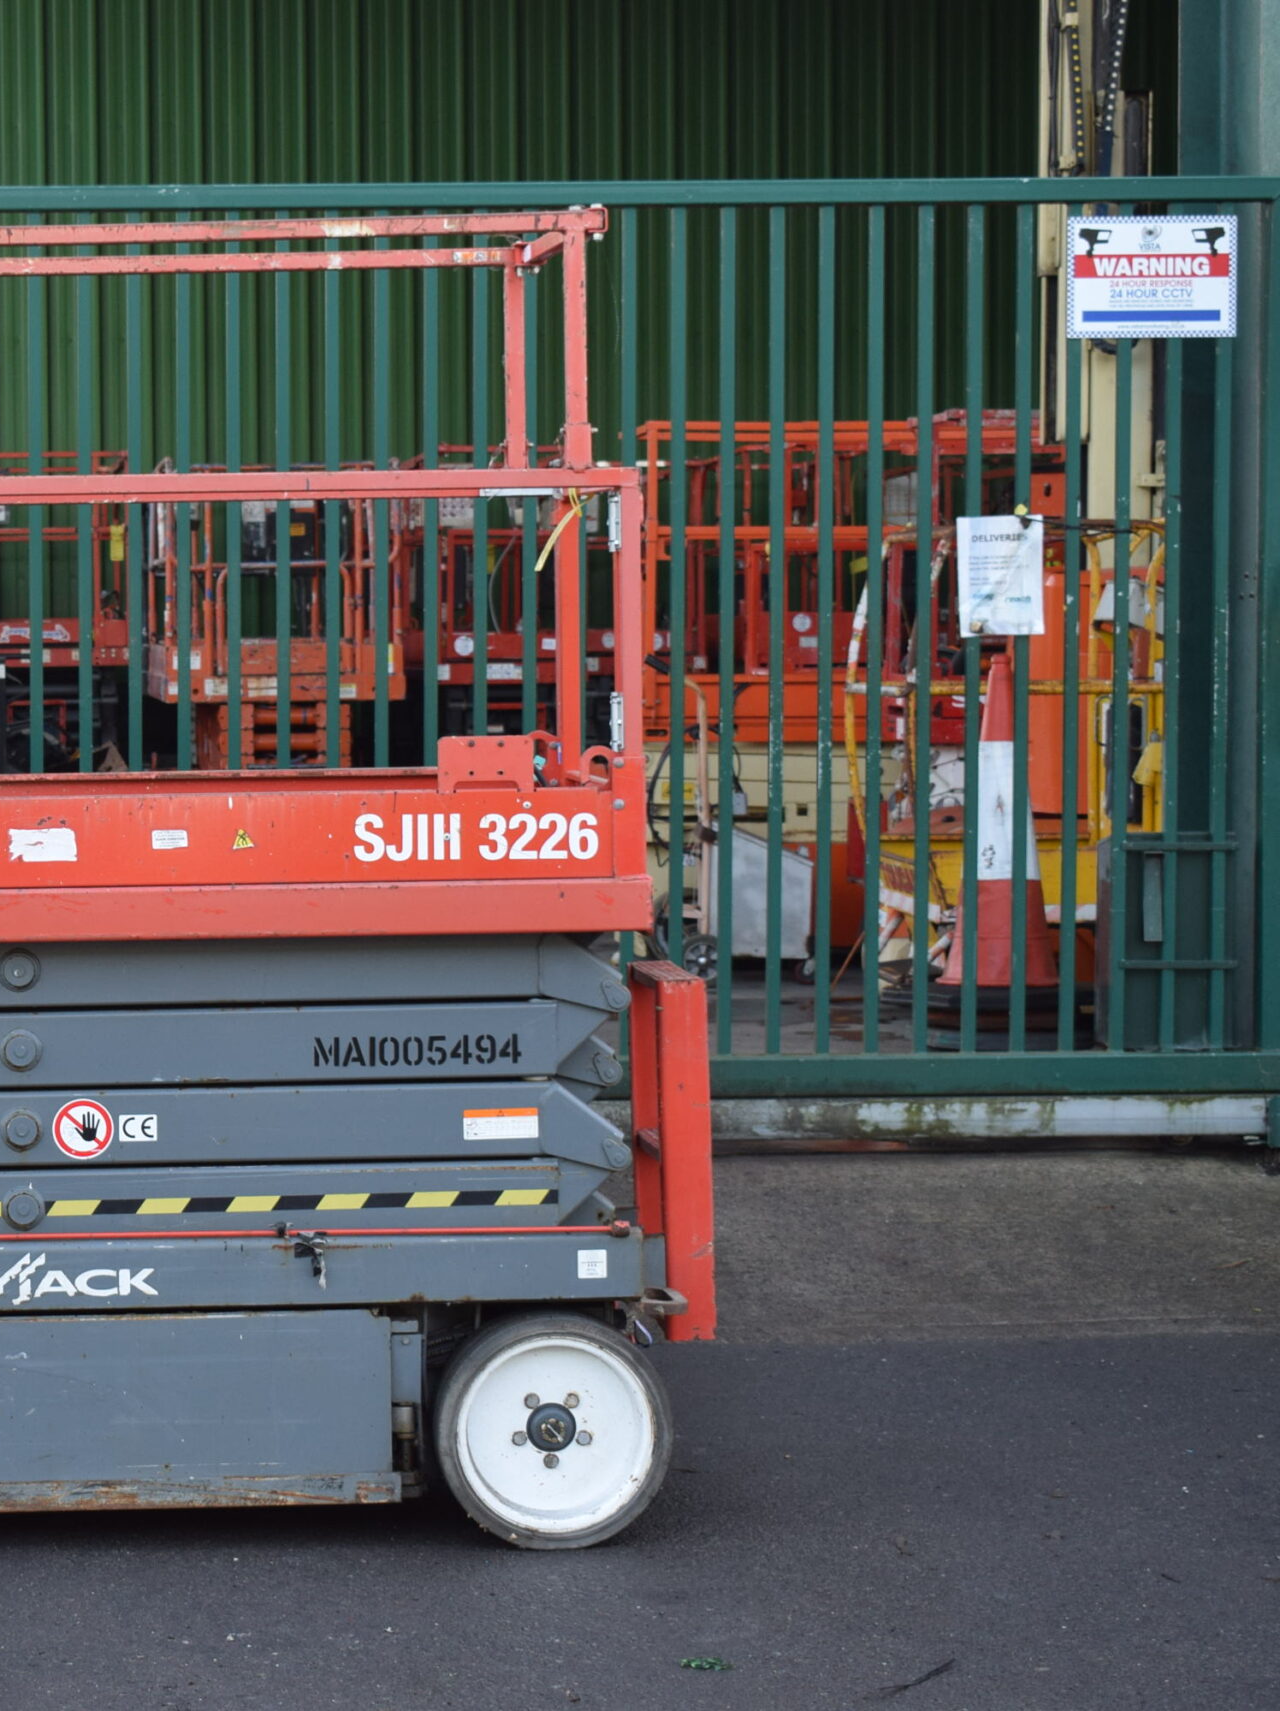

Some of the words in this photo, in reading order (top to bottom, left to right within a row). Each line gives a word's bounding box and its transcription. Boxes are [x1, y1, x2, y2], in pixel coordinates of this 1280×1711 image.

[1093, 257, 1210, 276] WARNING
[1109, 280, 1121, 288] 24
[1122, 280, 1147, 288] HOUR
[1150, 280, 1193, 288] RESPONSE
[1110, 289, 1123, 299] 24
[1126, 289, 1158, 299] HOUR
[1161, 288, 1193, 298] CCTV
[478, 812, 599, 860] 3226
[122, 1116, 154, 1139] CE
